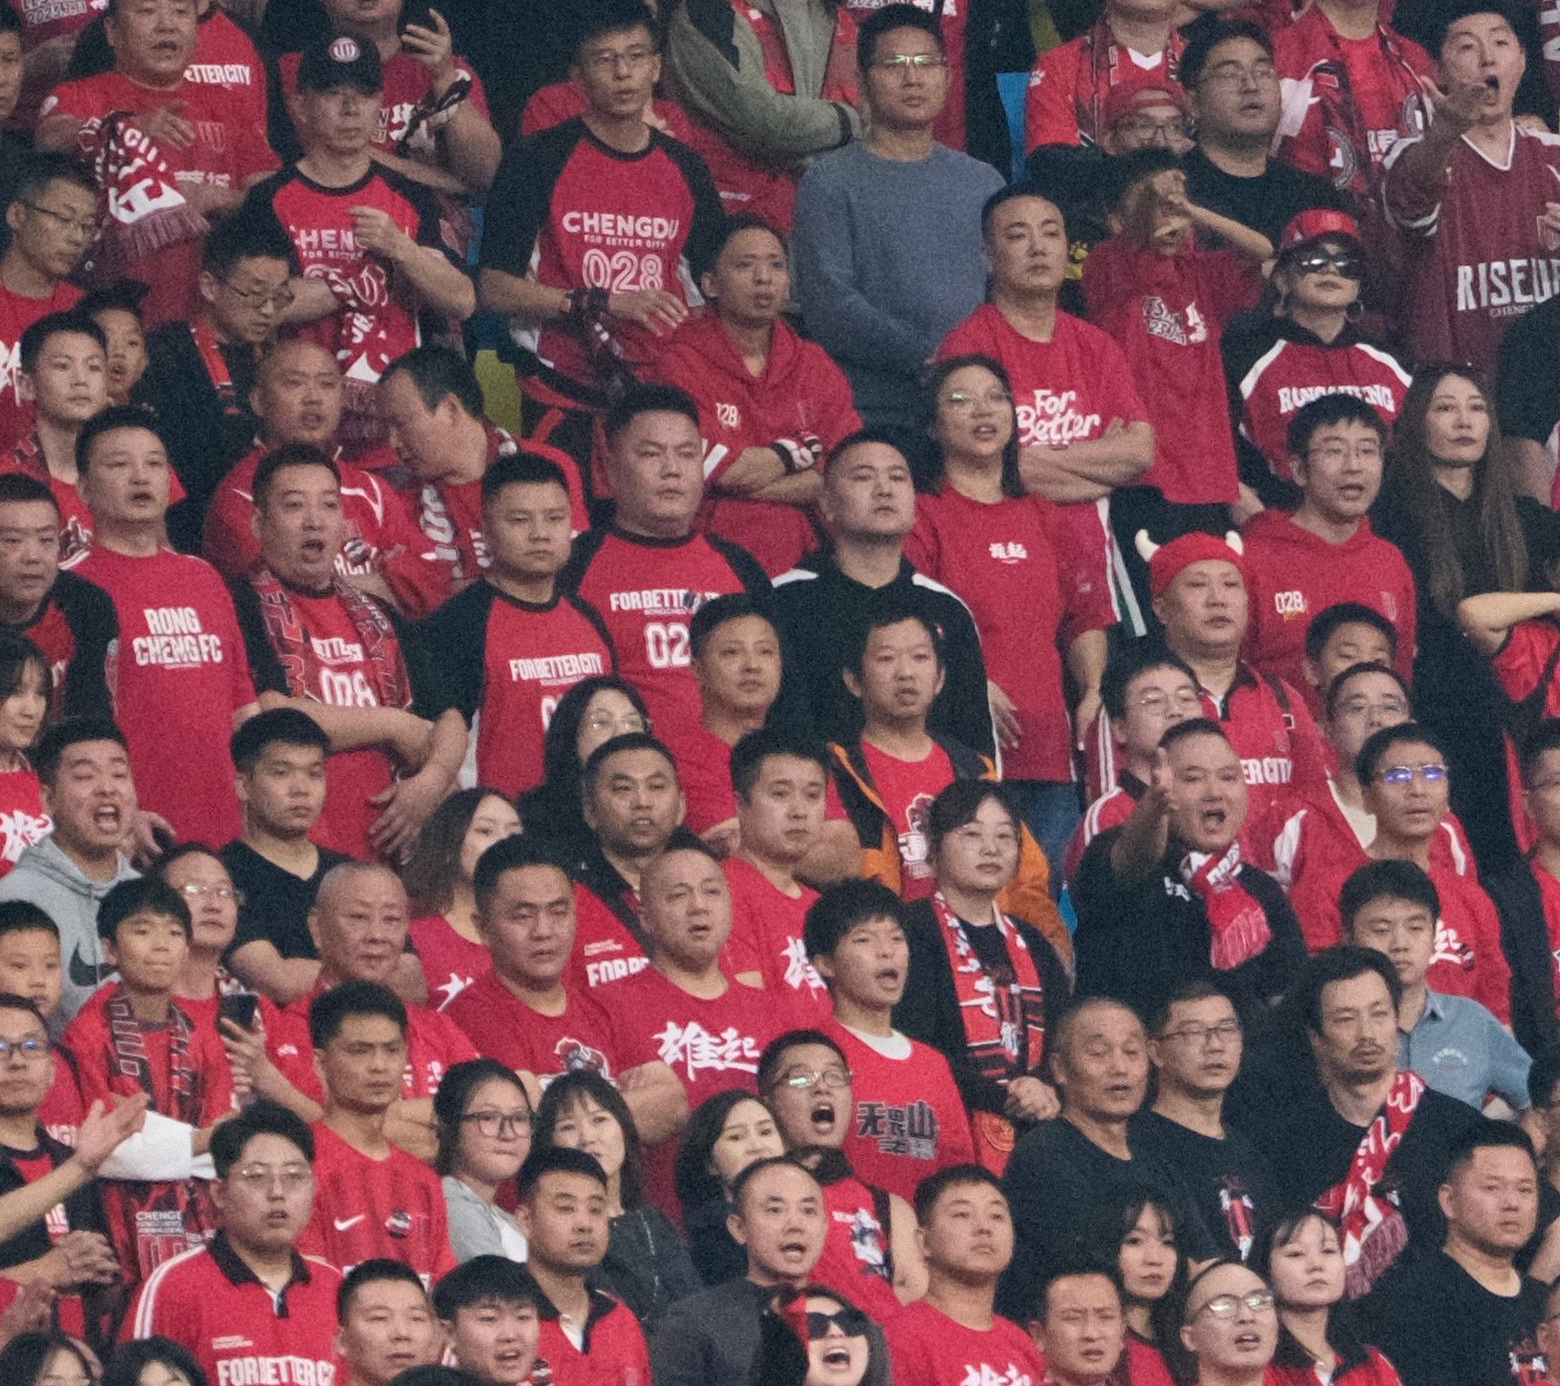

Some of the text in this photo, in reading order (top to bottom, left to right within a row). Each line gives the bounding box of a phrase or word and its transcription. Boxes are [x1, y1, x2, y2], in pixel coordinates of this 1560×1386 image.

[562, 213, 677, 241] CHENGDU
[583, 249, 663, 293] 028
[1034, 390, 1076, 415] For
[1016, 409, 1100, 444] Better
[1275, 591, 1305, 613] 028
[144, 609, 200, 632] RONG
[645, 623, 692, 667] 02
[653, 1021, 758, 1081] 雄起
